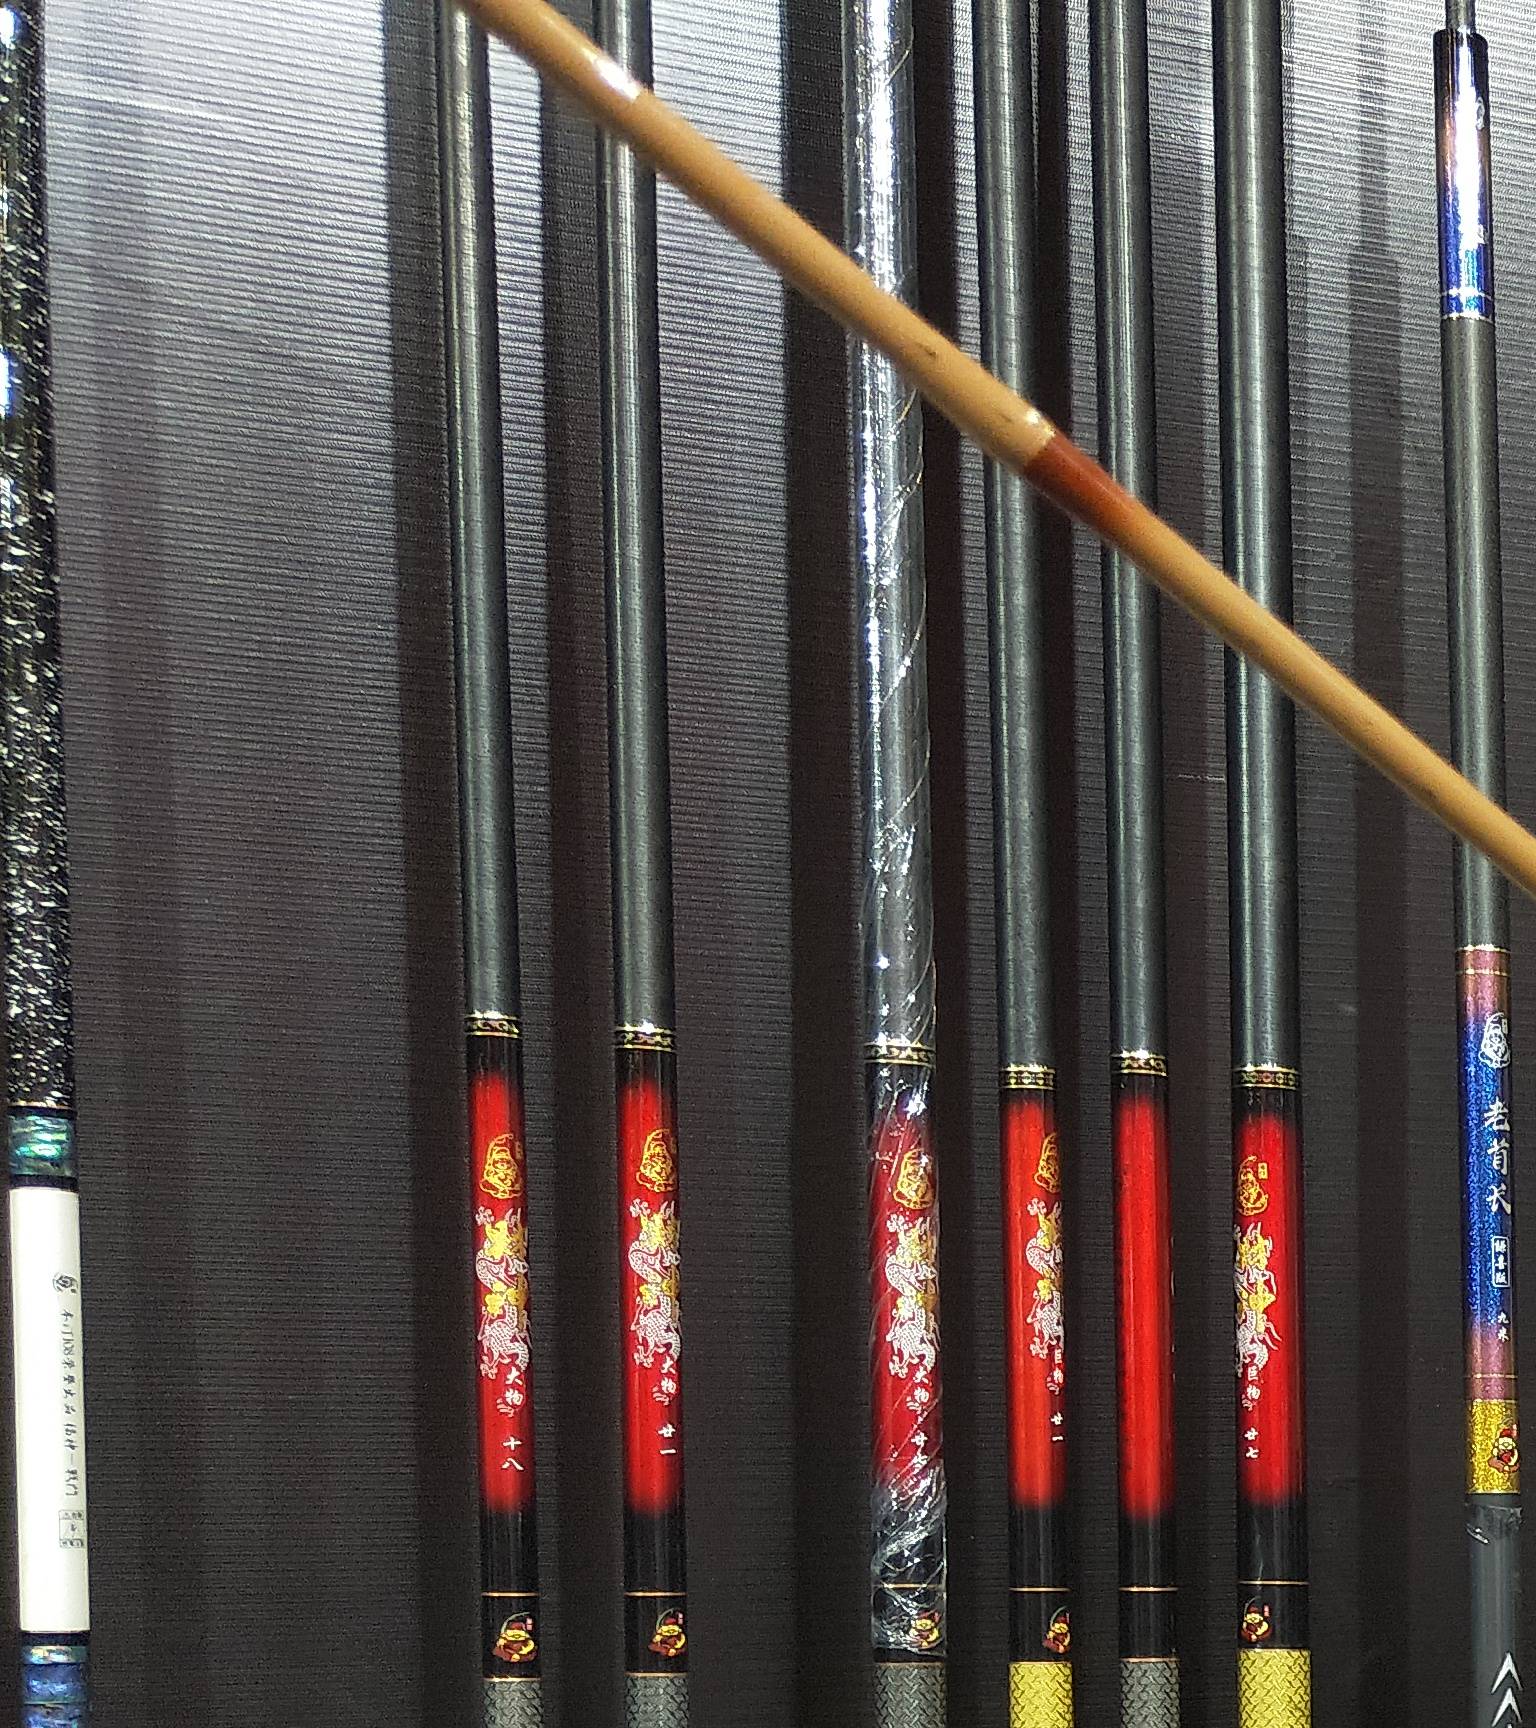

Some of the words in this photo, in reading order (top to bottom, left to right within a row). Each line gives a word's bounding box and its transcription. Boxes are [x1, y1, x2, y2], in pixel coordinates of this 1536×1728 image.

[1483, 1097, 1512, 1215] 老首长
[501, 1436, 525, 1471] 十八
[657, 1423, 677, 1456] 廿一
[1243, 1426, 1260, 1459] 廿七
